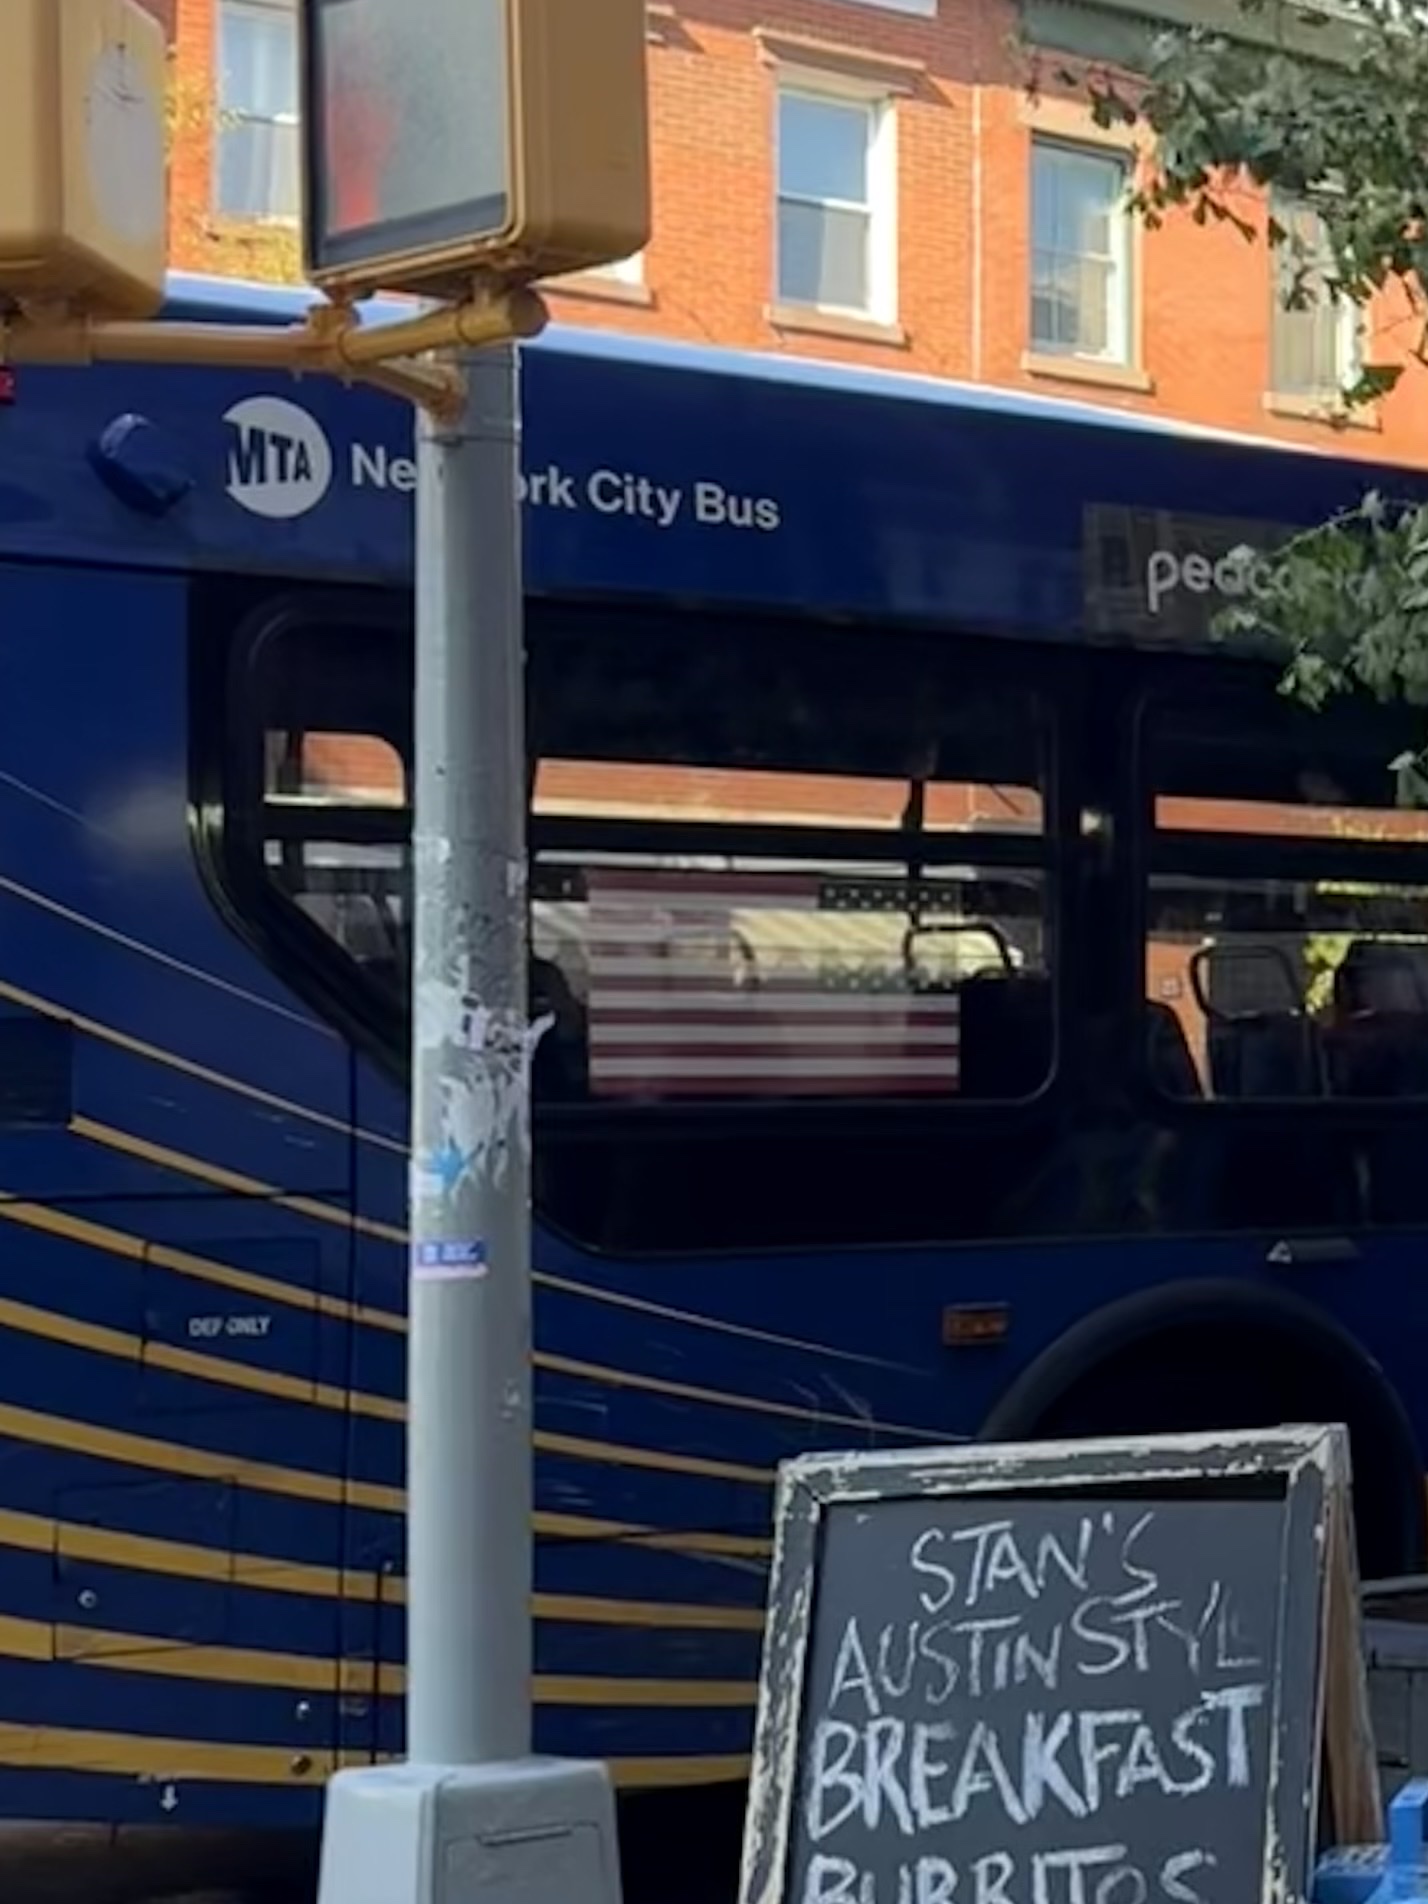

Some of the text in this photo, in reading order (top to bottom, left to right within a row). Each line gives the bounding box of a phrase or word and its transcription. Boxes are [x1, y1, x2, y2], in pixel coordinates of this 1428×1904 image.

[352, 442, 417, 492] Ne
[587, 469, 682, 526] City
[695, 482, 781, 530] Bus
[910, 1511, 1159, 1614] STAN'S
[827, 1615, 1063, 1715] AUSTIN
[805, 1684, 1267, 1842] BREAKFAST
